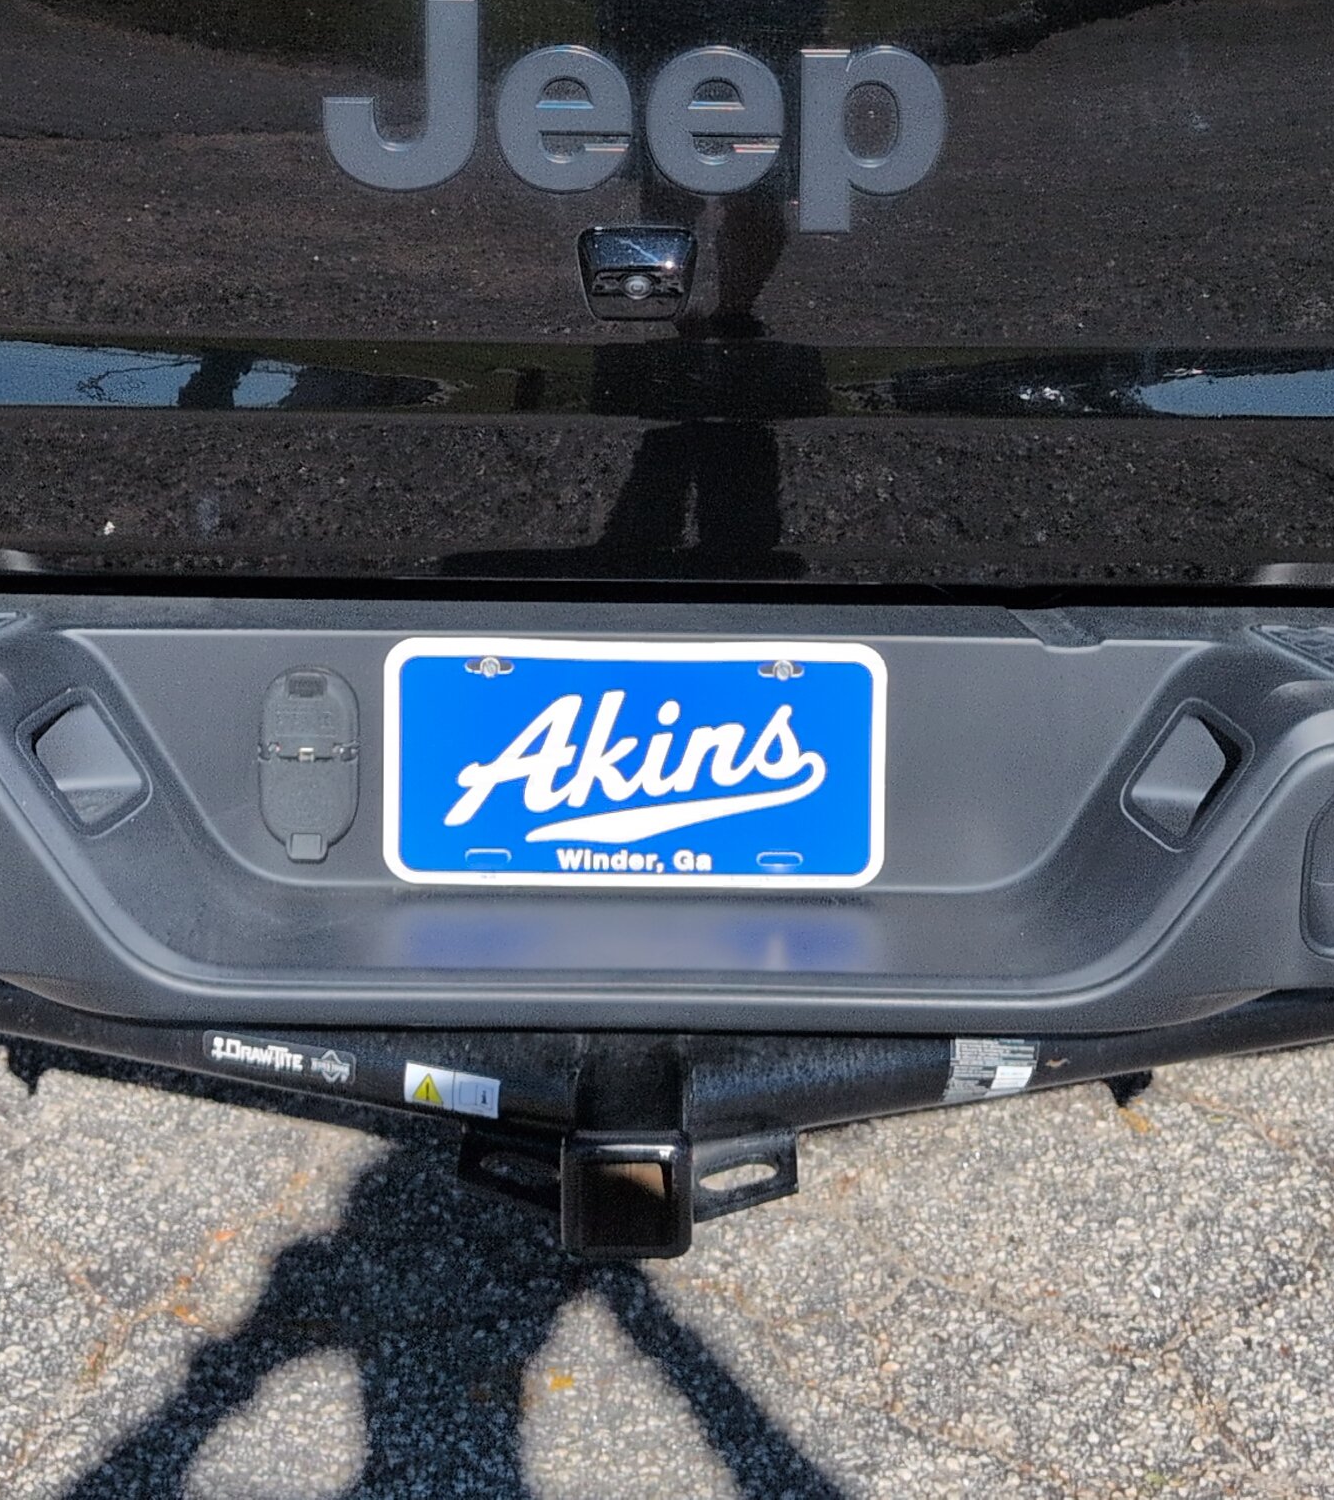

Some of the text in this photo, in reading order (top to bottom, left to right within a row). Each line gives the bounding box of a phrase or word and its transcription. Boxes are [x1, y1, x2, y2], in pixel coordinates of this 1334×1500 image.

[444, 690, 826, 843] Akins
[556, 848, 713, 873] Winder, Ga
